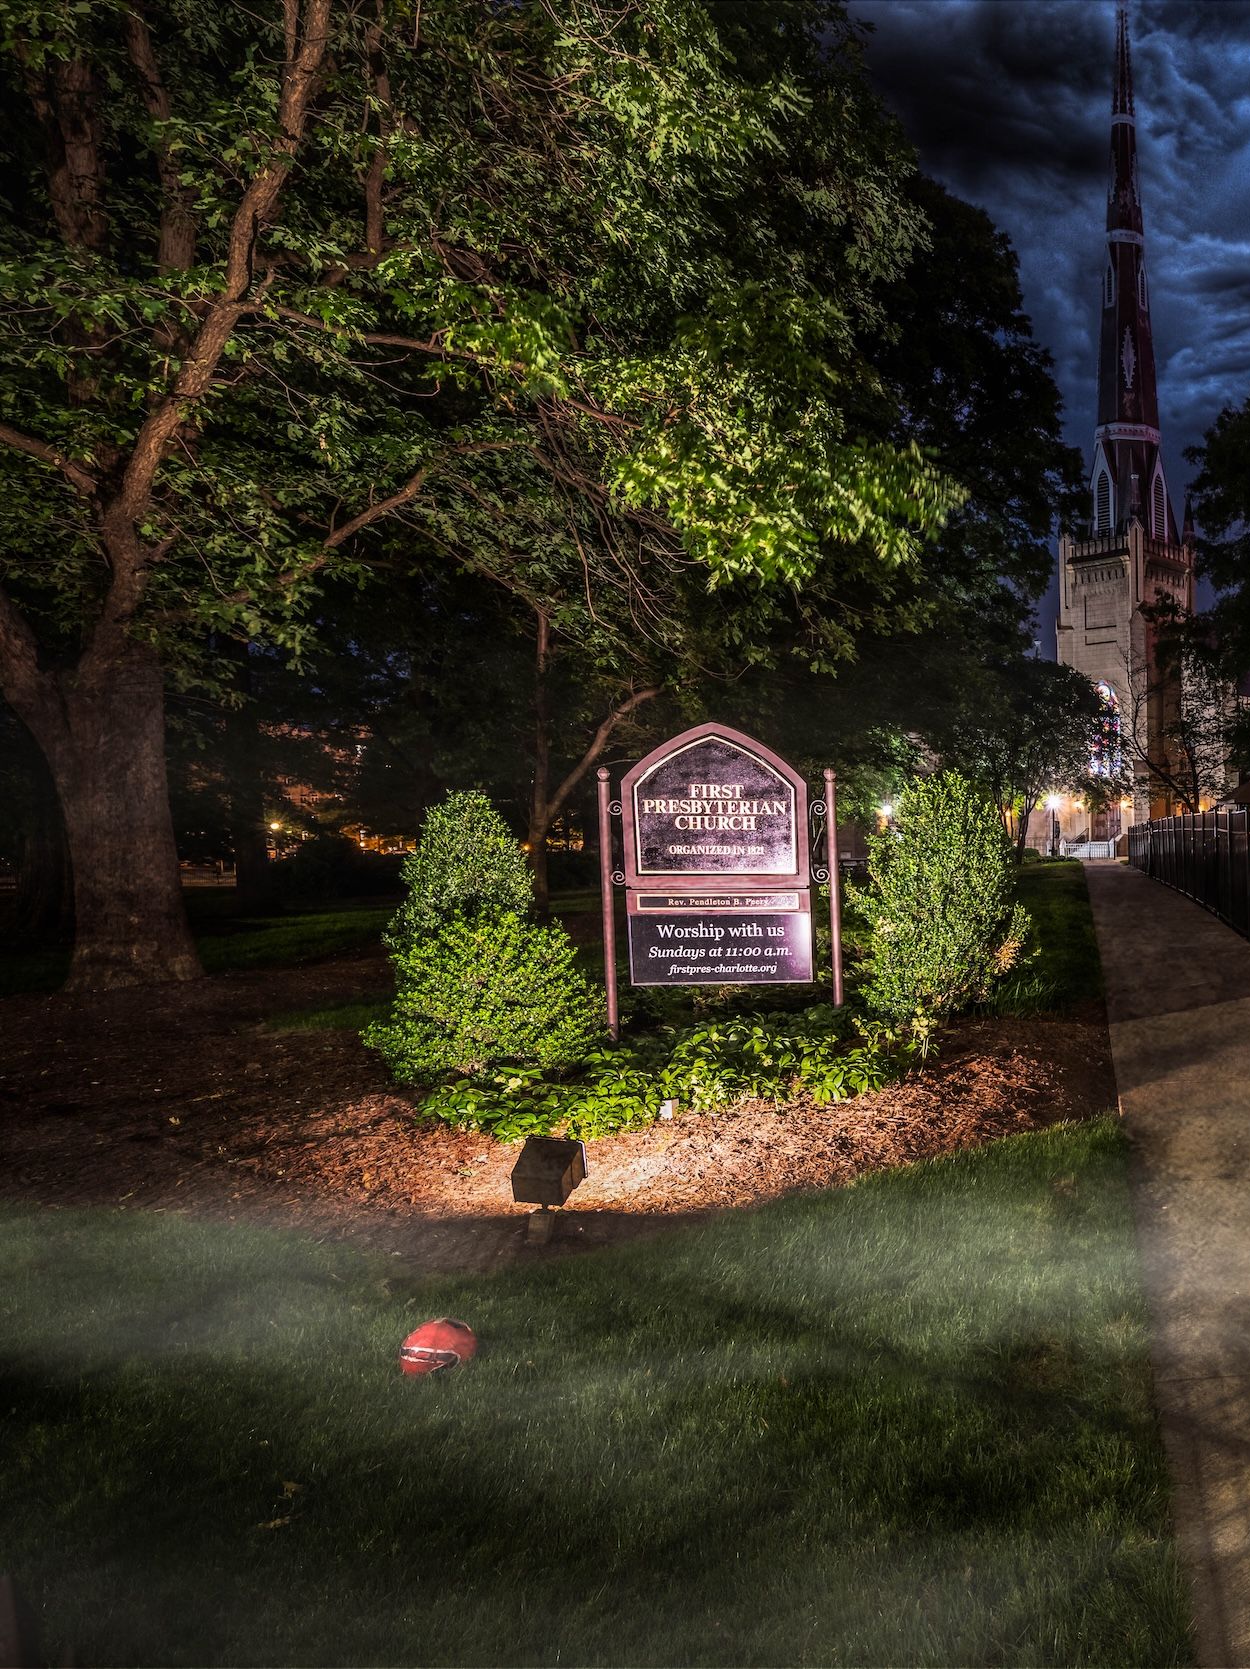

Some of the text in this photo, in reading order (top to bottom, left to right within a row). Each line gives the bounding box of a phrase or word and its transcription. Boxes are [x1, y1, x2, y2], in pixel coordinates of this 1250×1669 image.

[690, 784, 744, 798] FIRST
[643, 799, 786, 815] PRESBYTERIAN
[674, 815, 757, 830] CHURCH
[669, 845, 764, 855] ORGANIZED IN 1821
[656, 922, 785, 940] Worship with us
[649, 946, 792, 960] Sundays at 11:00 a.m.
[668, 963, 777, 975] firstpres-charlotte.org
